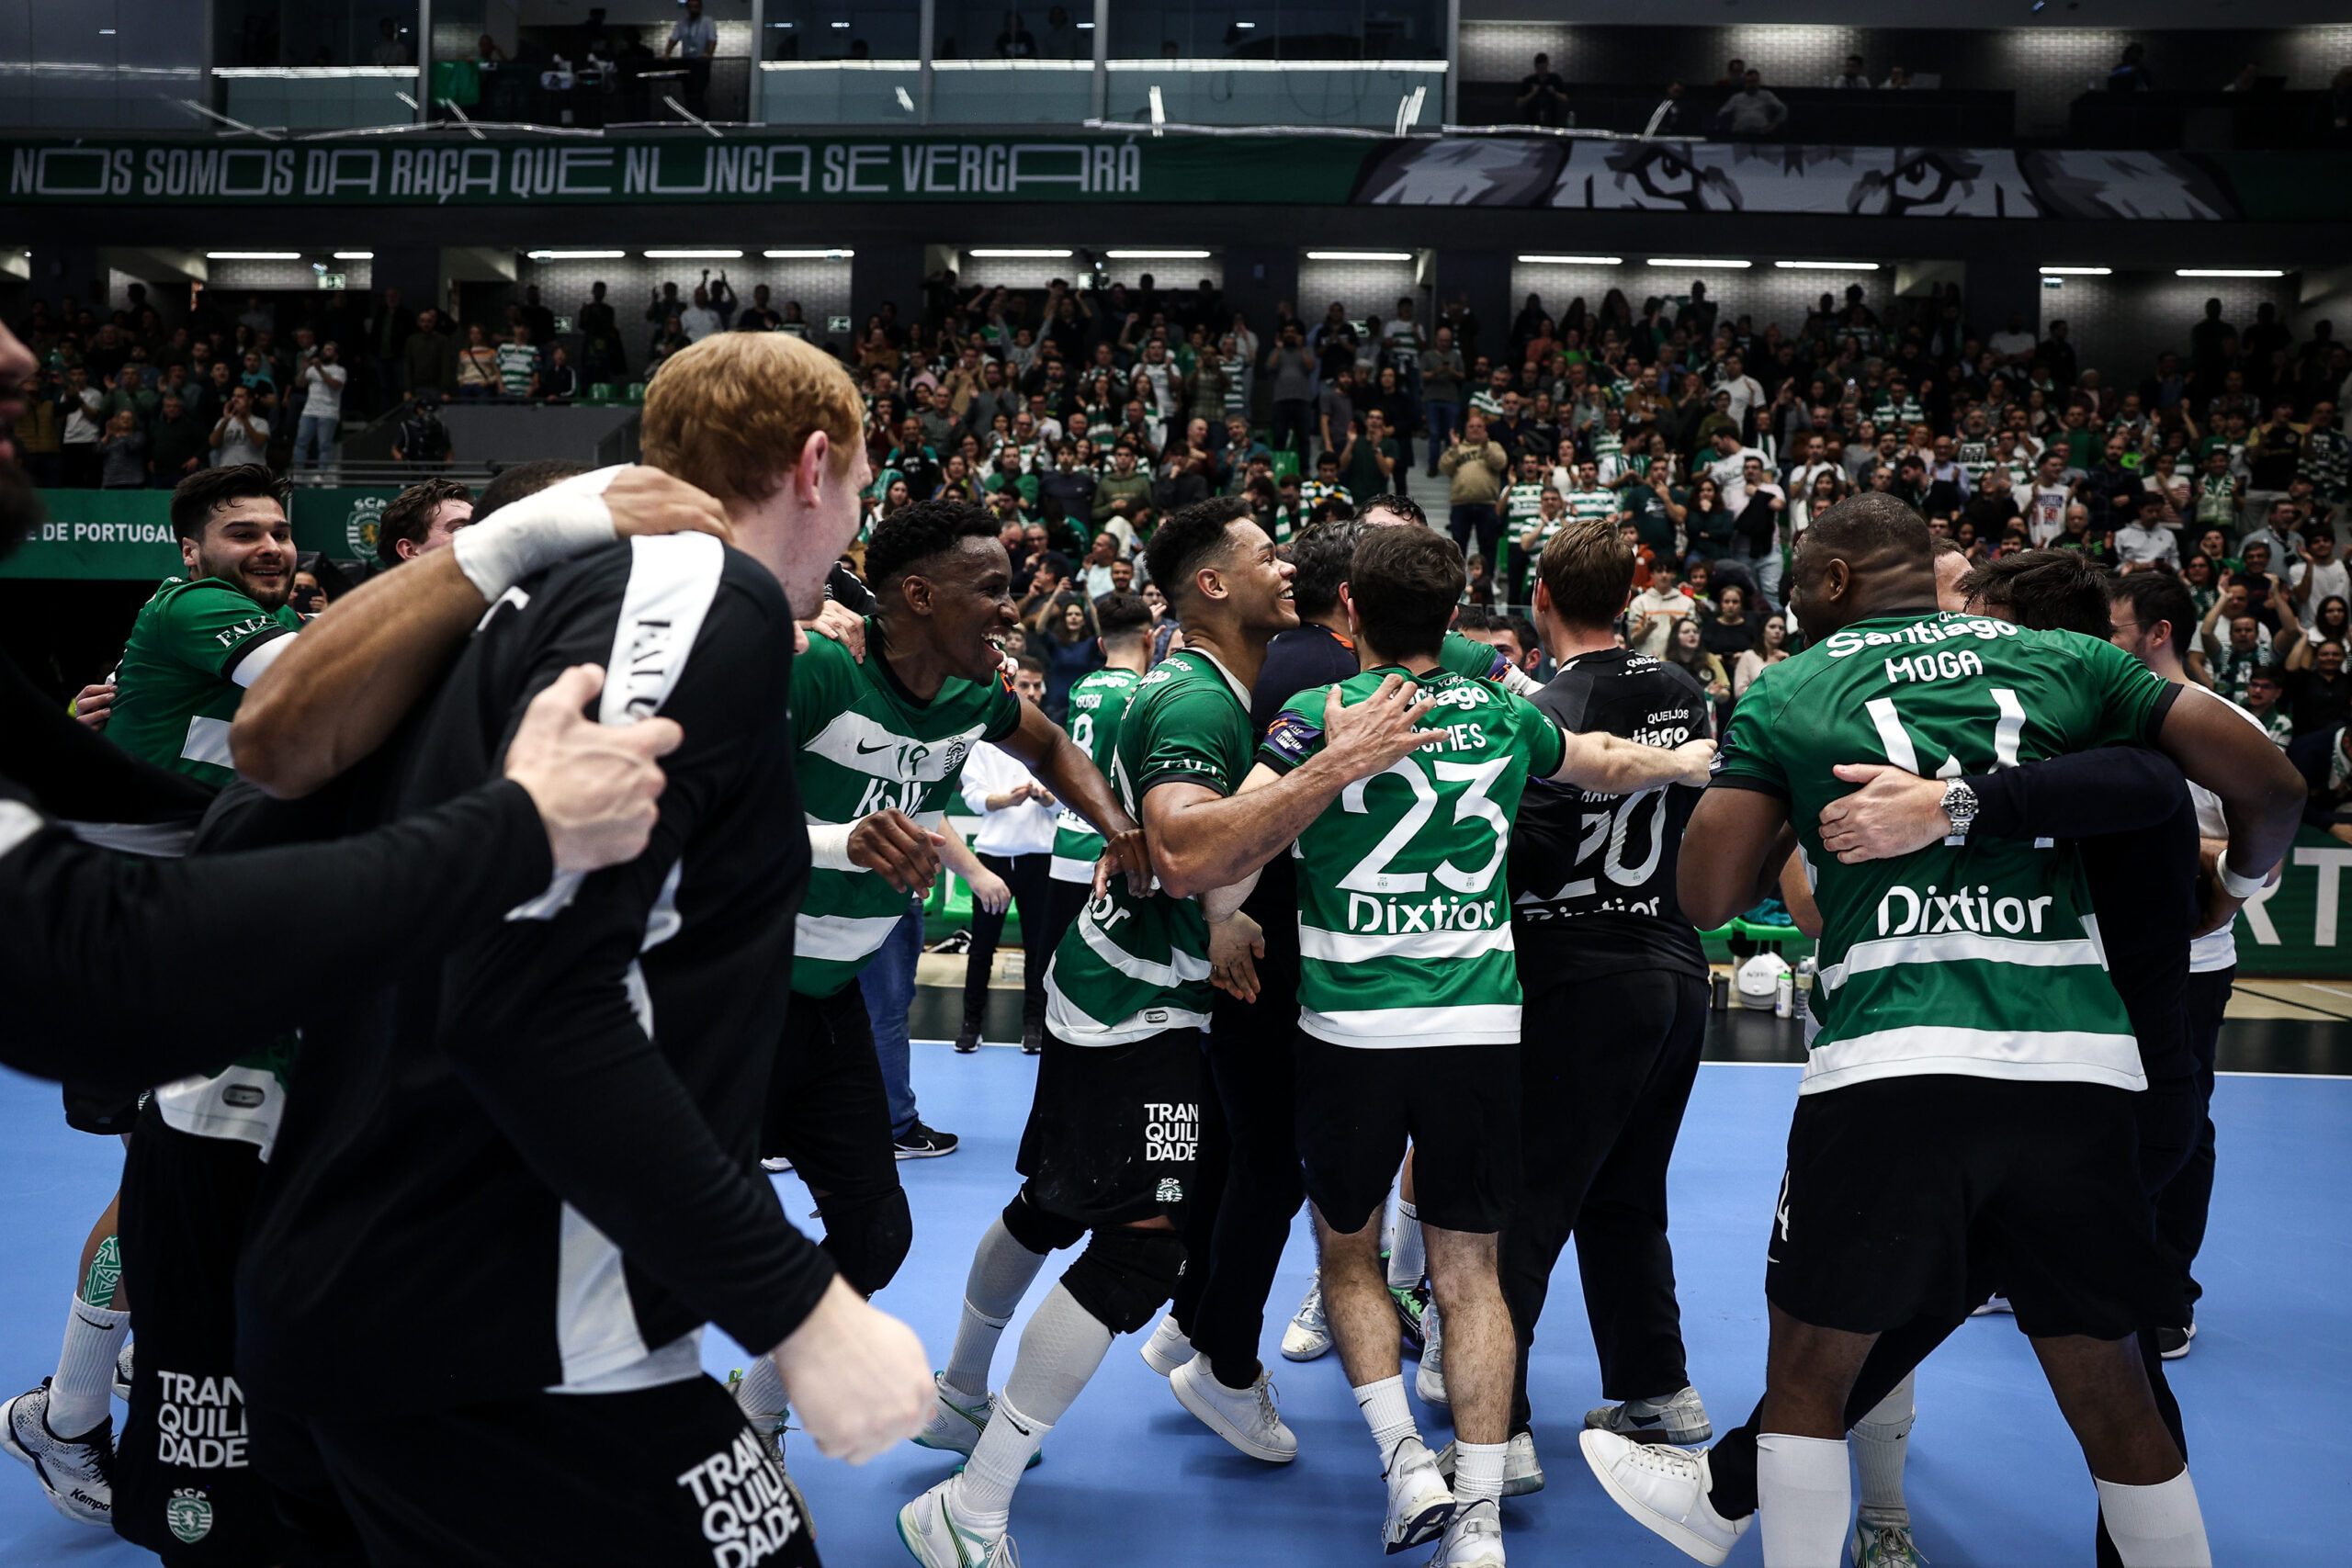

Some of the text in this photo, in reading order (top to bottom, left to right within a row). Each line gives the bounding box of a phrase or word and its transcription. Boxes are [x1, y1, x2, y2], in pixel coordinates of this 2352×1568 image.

[143, 148, 294, 196] SOMOS
[305, 148, 379, 195] DA
[390, 149, 500, 204] RAÇA
[511, 147, 615, 195] QUE
[624, 145, 811, 193] NUNCA
[823, 144, 891, 192] SE
[903, 136, 1140, 192] VERGARÁ
[42, 524, 69, 541] DE
[74, 524, 177, 543] PORTUGAL
[1826, 619, 2018, 658] Santiago
[1884, 649, 1984, 683] MOGA
[1647, 709, 1689, 724] QUEIJOS
[898, 744, 930, 778] 19
[1336, 753, 1514, 894] 23
[1348, 892, 1496, 934] Dixtior
[1877, 885, 2053, 936] Dixtior
[1143, 1102, 1199, 1122] TRAN
[1145, 1122, 1199, 1145] QUILI
[1146, 1142, 1198, 1161] DADE
[157, 1370, 245, 1407] TRAN
[157, 1403, 249, 1440] QUILI
[158, 1430, 250, 1469] DADE
[676, 1426, 766, 1508] TRAN
[70, 1487, 111, 1511] Kempa
[173, 1488, 207, 1499] SCP
[712, 1491, 801, 1568] DADE
